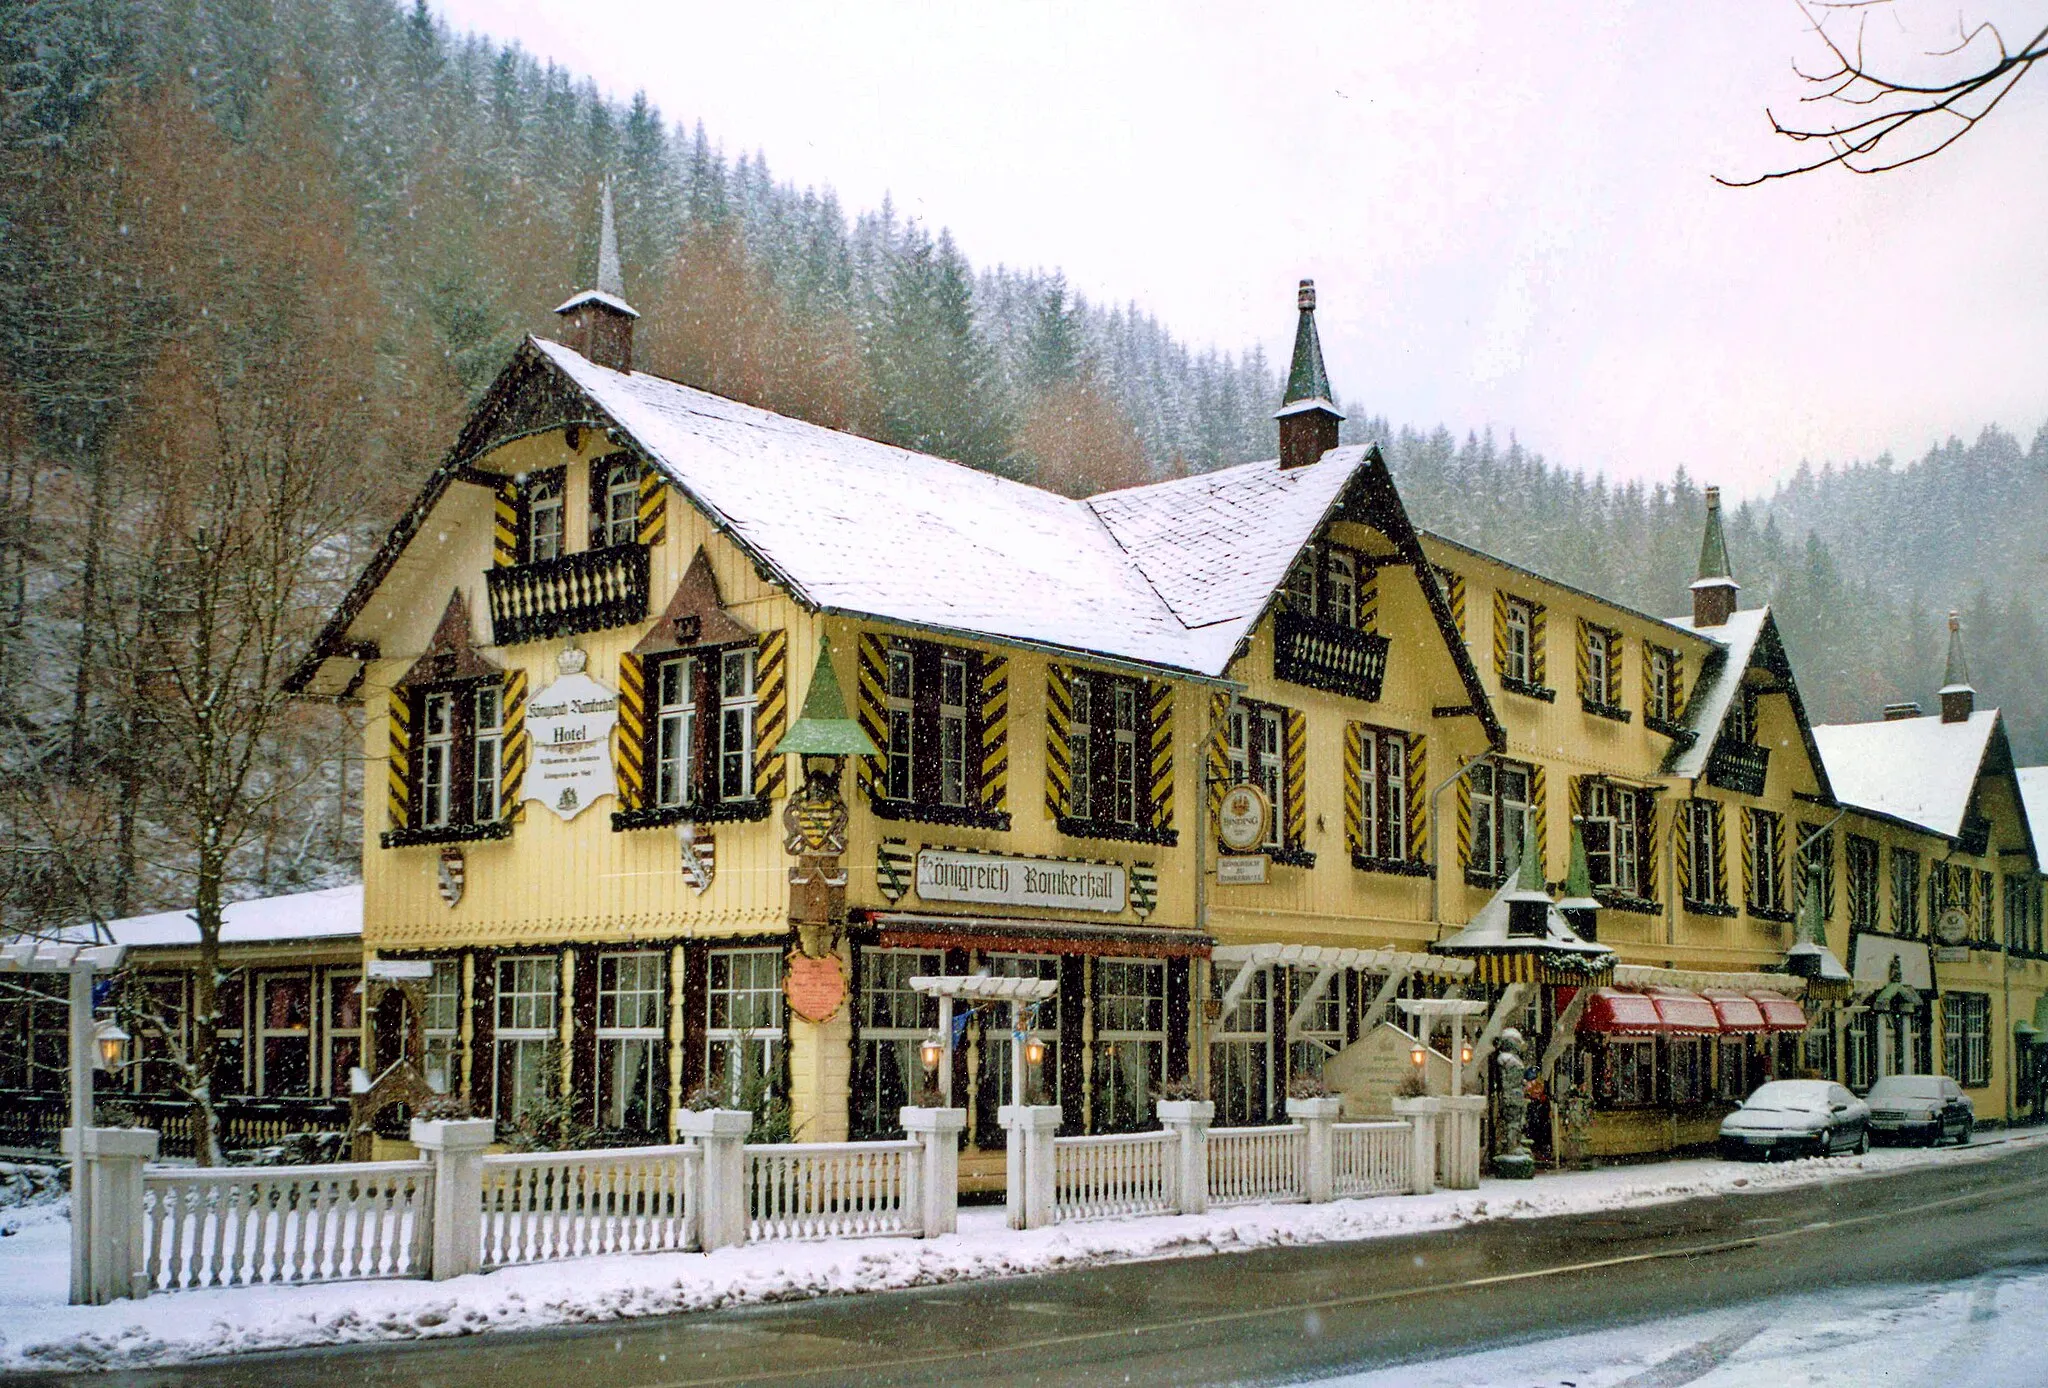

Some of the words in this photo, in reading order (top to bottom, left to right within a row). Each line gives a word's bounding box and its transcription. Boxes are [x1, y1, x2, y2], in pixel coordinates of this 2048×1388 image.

[554, 725, 586, 742] Hotel
[1223, 816, 1258, 826] BINDING
[920, 855, 1009, 893] Königreich
[1023, 865, 1113, 899] Romkerhall
